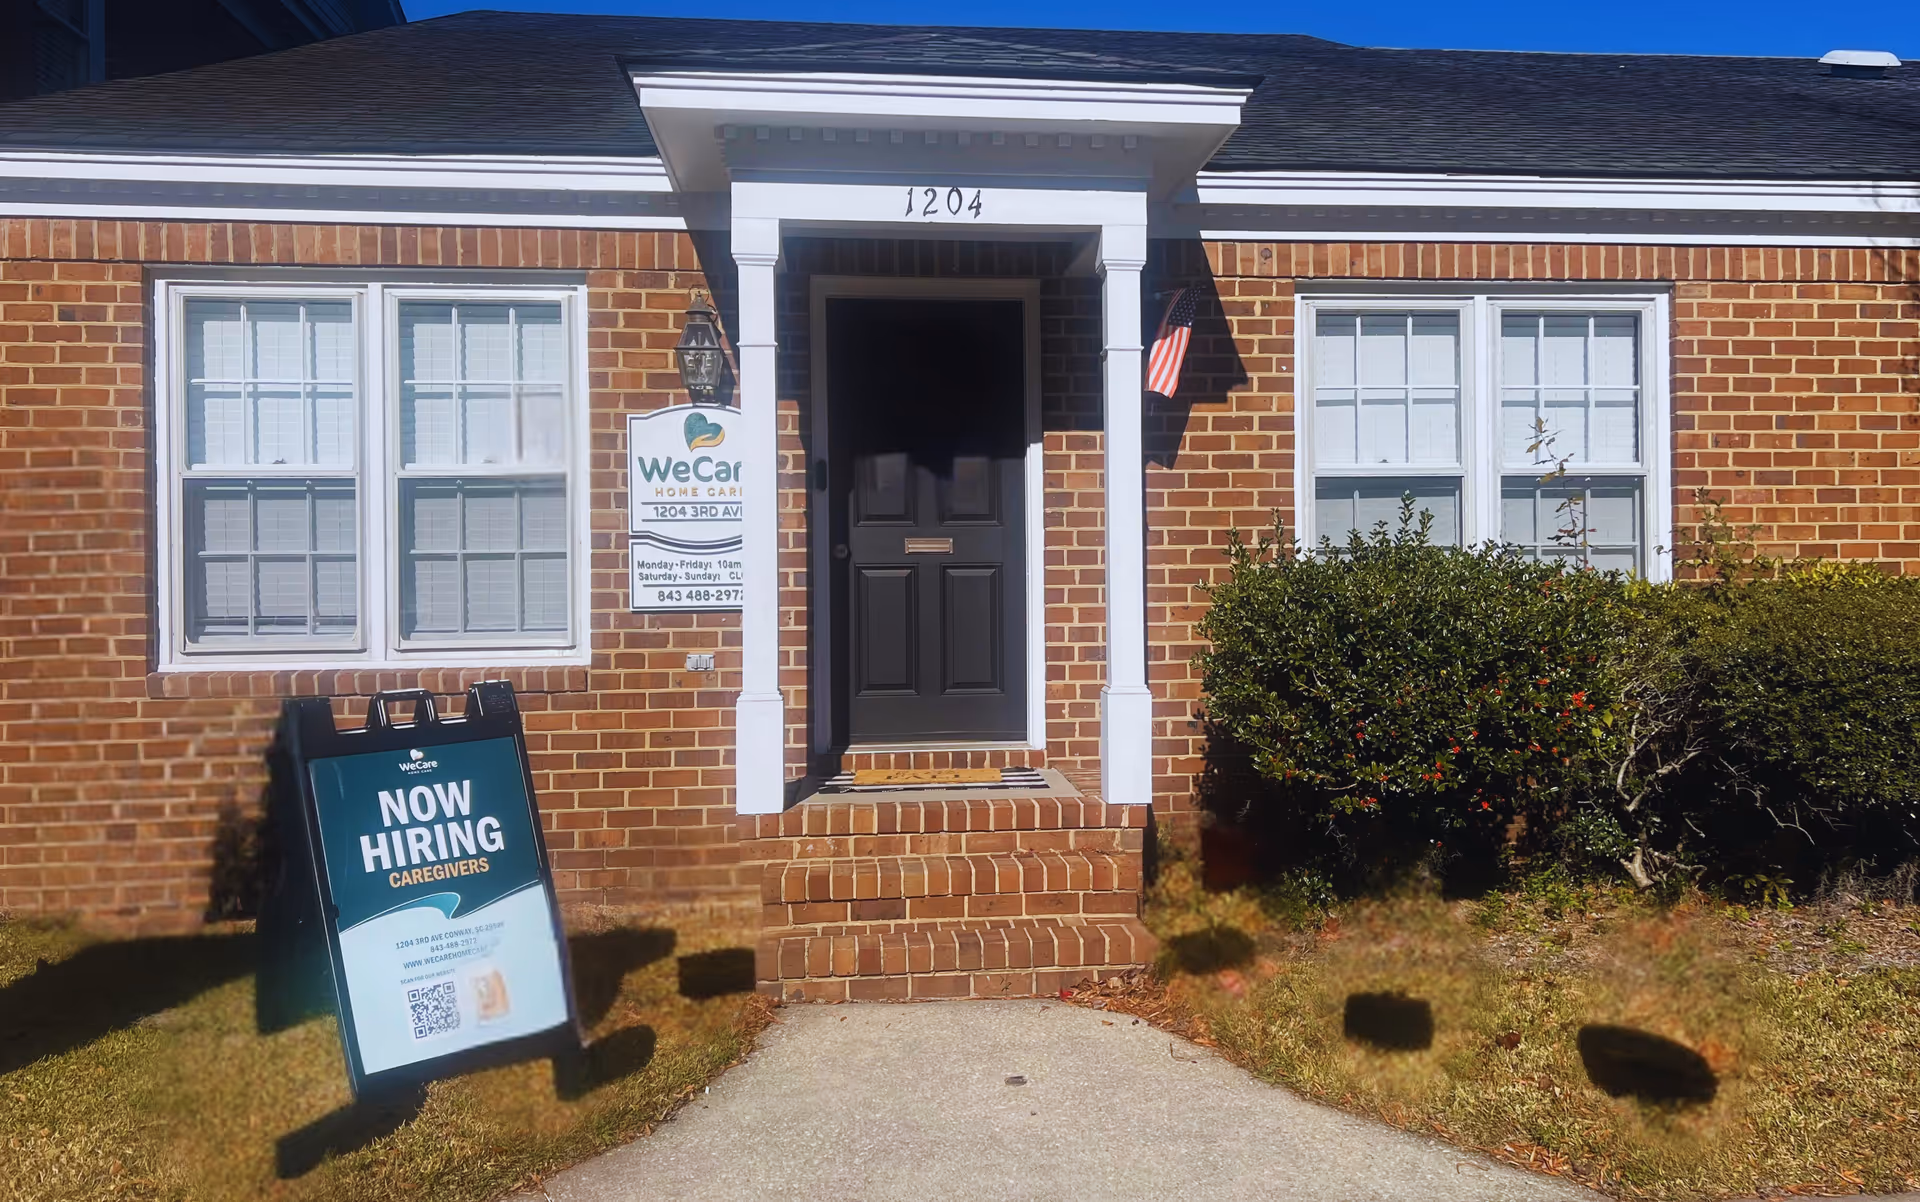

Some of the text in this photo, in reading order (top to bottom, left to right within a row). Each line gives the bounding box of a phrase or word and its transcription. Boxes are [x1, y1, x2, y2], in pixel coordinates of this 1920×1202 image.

[905, 187, 982, 219] 1204
[638, 456, 742, 483] WeCar
[655, 487, 698, 497] HOME
[653, 506, 687, 518] 1204
[690, 506, 718, 518] 3RD
[658, 590, 682, 602] 843
[399, 761, 438, 772] WeCare
[378, 780, 470, 827] NOW
[360, 816, 505, 873] HIRING
[389, 857, 490, 888] CAREGIVERS
[395, 940, 414, 950] 1204
[415, 936, 430, 946] 3RD
[430, 933, 444, 943] AVE
[430, 937, 477, 953] 843-488-2972
